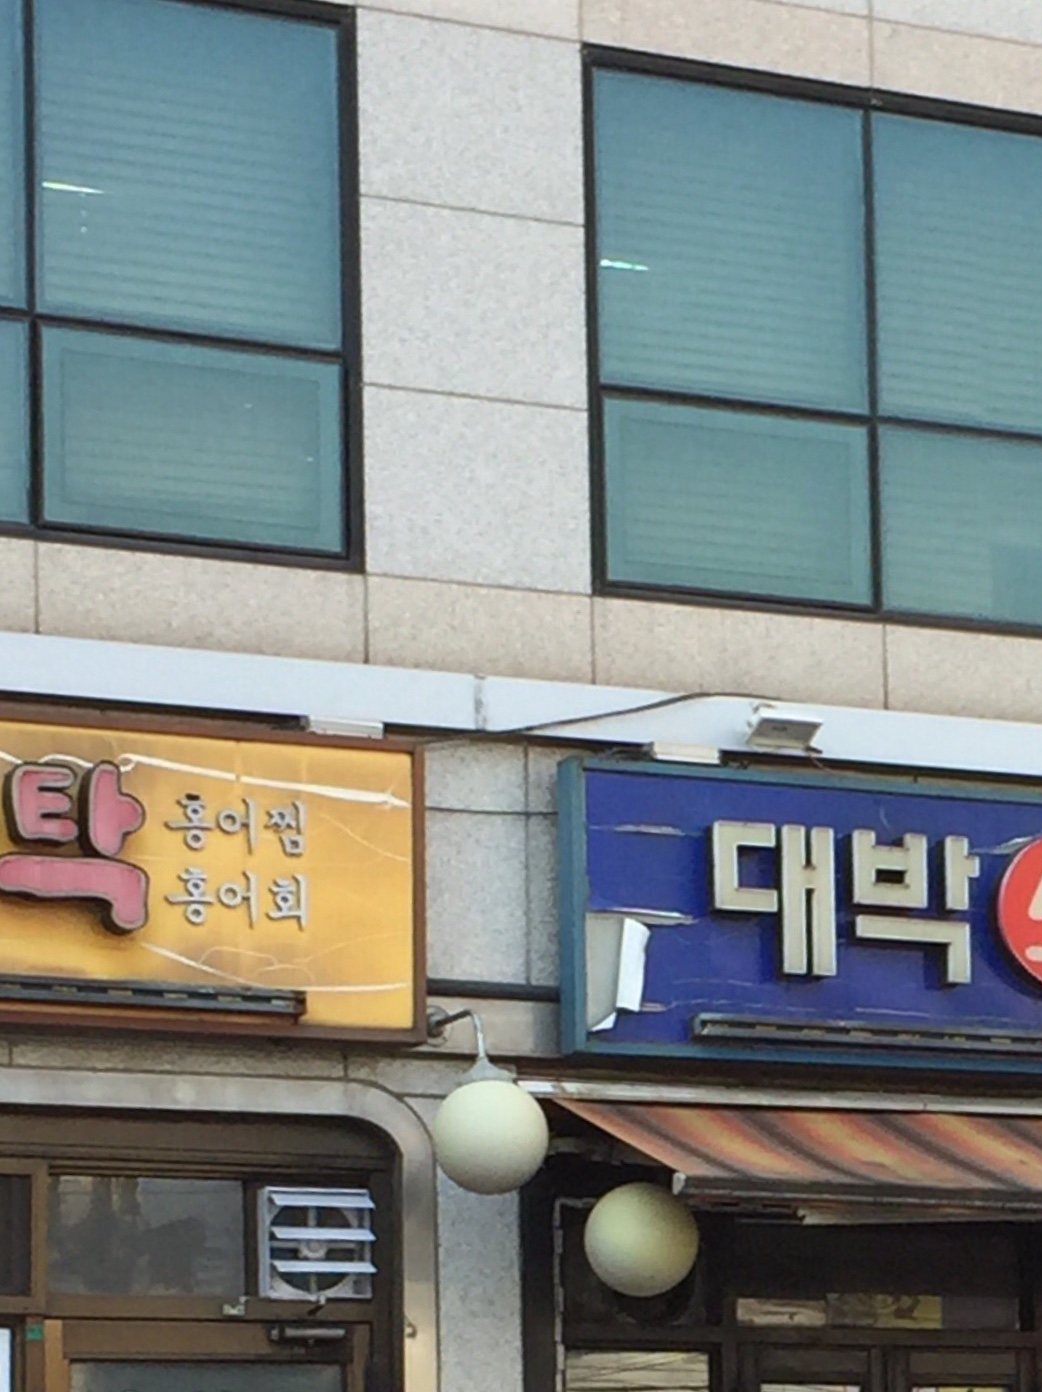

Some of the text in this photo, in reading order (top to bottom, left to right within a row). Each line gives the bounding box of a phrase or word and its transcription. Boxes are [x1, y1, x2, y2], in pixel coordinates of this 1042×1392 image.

[163, 793, 308, 857] 홍어찜
[163, 867, 308, 931] 홍어회
[710, 820, 980, 984] 대박
